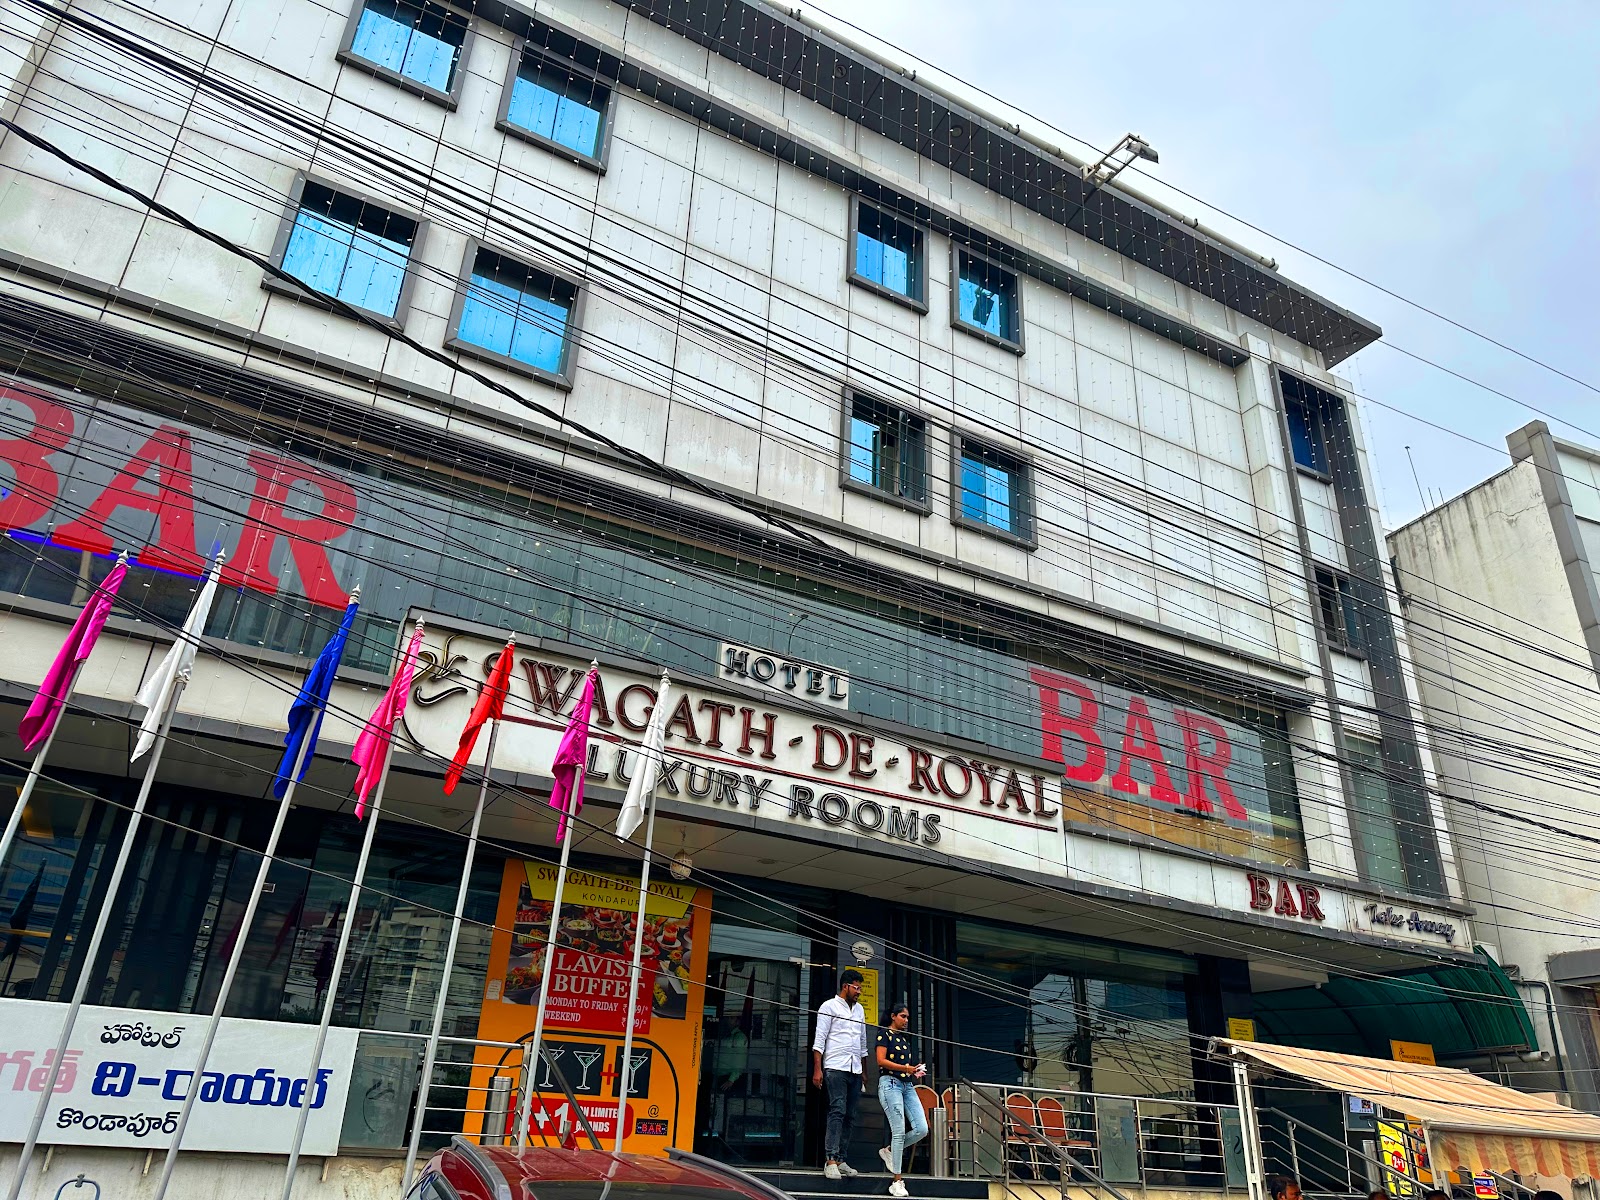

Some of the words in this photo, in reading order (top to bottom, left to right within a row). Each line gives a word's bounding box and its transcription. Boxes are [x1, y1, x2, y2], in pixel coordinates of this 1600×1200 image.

[0, 380, 358, 611] BAR
[725, 647, 847, 700] HOTEL
[1030, 667, 1249, 822] BAR
[812, 723, 878, 779] DE
[907, 746, 1059, 818] ROYAL
[586, 744, 772, 810] LUXURY
[788, 784, 942, 844] ROOMS
[582, 892, 640, 907] KONDAPUR
[638, 880, 685, 900] OYAL
[1247, 873, 1326, 921] BAR
[1363, 903, 1406, 928] Take
[1406, 911, 1456, 943] Away
[555, 952, 645, 979] LAVISH
[553, 973, 646, 1000] BUFFET
[544, 1010, 581, 1022] WEEKEND
[545, 996, 578, 1009] MONDAY
[580, 999, 590, 1009] TO
[591, 1000, 619, 1011] FRIDAY
[100, 1022, 186, 1049] హోటల్
[56, 1107, 181, 1138] కొండాపూర్
[590, 1106, 620, 1119] LIMITE
[641, 1123, 662, 1133] BAR
